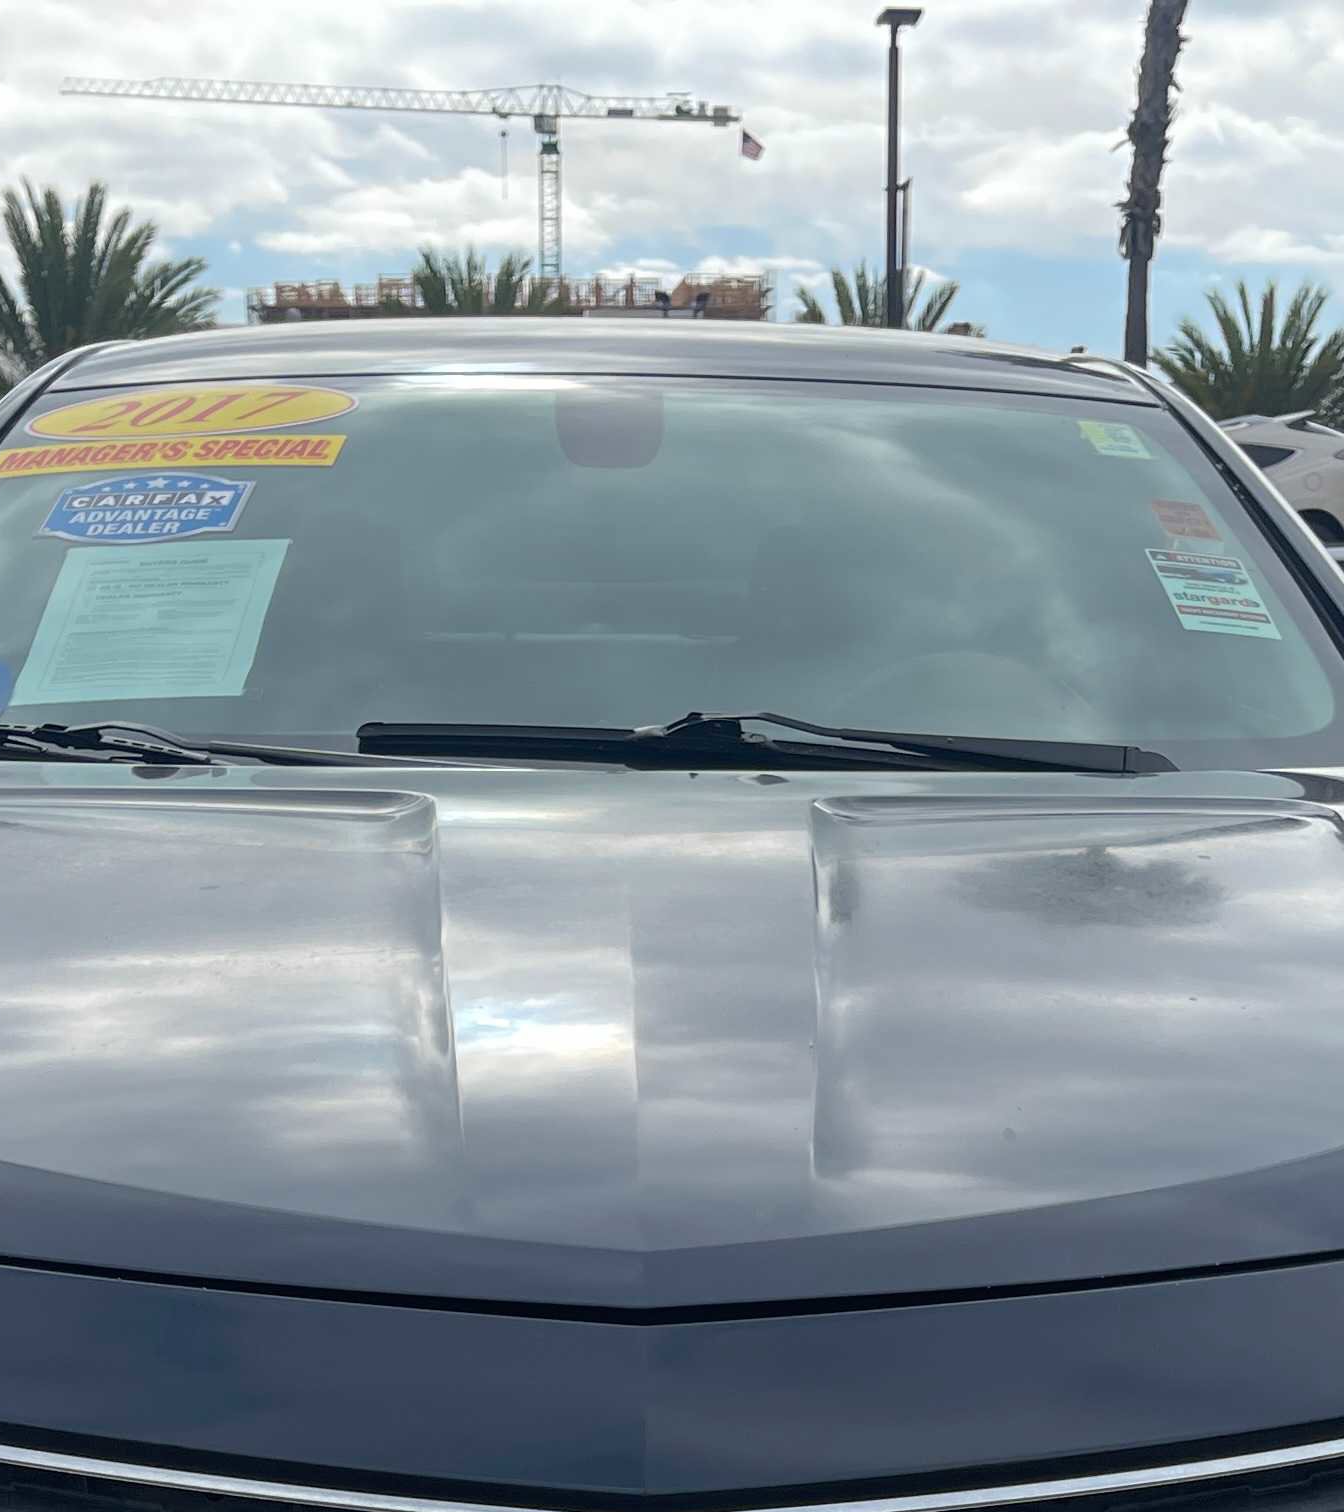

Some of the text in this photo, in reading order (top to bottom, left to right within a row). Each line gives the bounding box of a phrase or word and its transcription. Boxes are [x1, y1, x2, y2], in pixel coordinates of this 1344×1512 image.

[67, 391, 313, 433] 2017
[194, 437, 332, 461] SPECIAL
[67, 491, 233, 510] CARFAX
[69, 508, 211, 524] ADVANTAGE
[86, 521, 181, 536] DEALER
